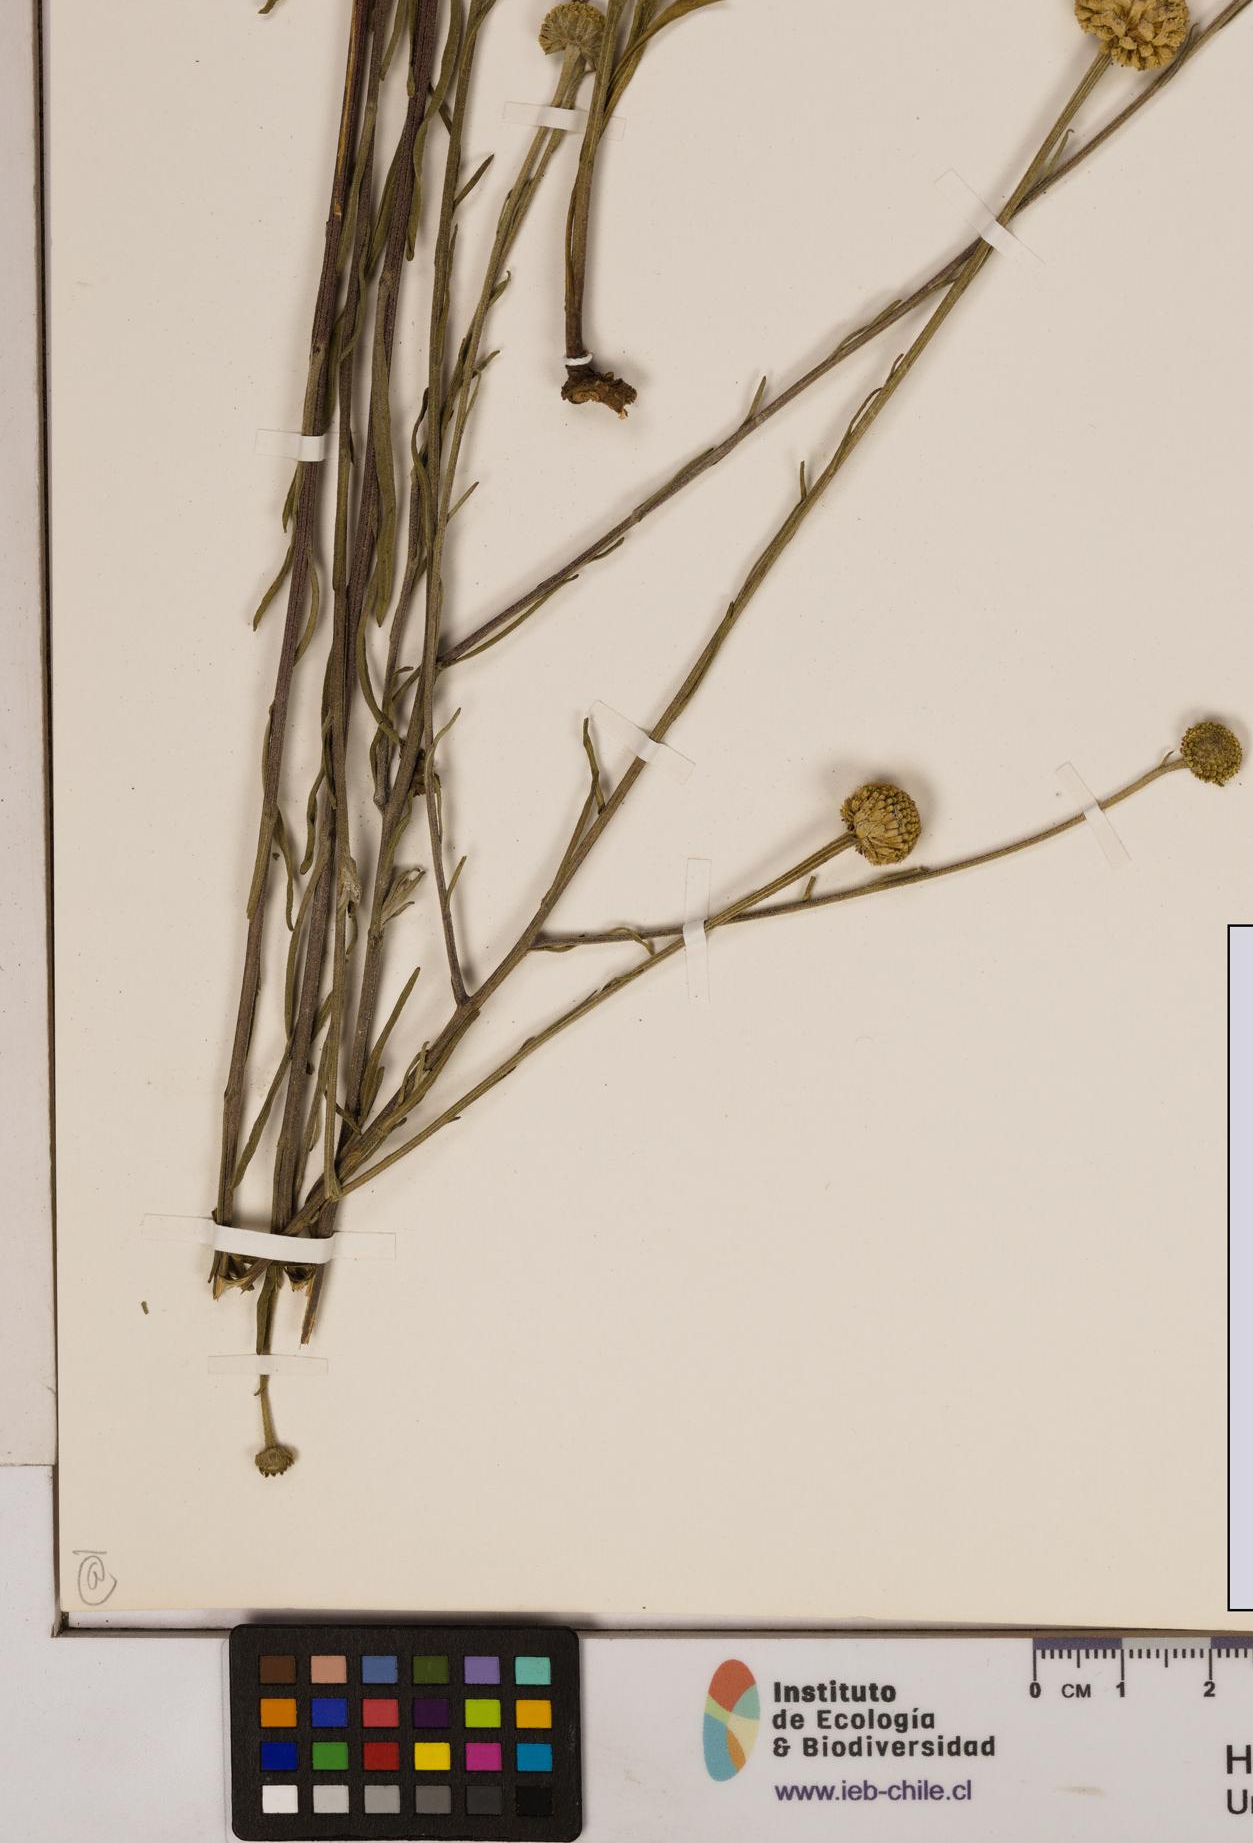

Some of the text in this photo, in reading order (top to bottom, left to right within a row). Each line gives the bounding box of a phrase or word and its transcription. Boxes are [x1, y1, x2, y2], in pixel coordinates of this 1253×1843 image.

[773, 1679, 897, 1704] Instituto
[1028, 1681, 1042, 1699] 0
[1060, 1683, 1092, 1699] CM
[1115, 1681, 1126, 1698] 1
[1202, 1681, 1216, 1698] 2
[772, 1707, 935, 1734] de Ecología
[772, 1735, 996, 1758] & Biodiversidad
[774, 1779, 972, 1802] www.ieb-chile.cl
